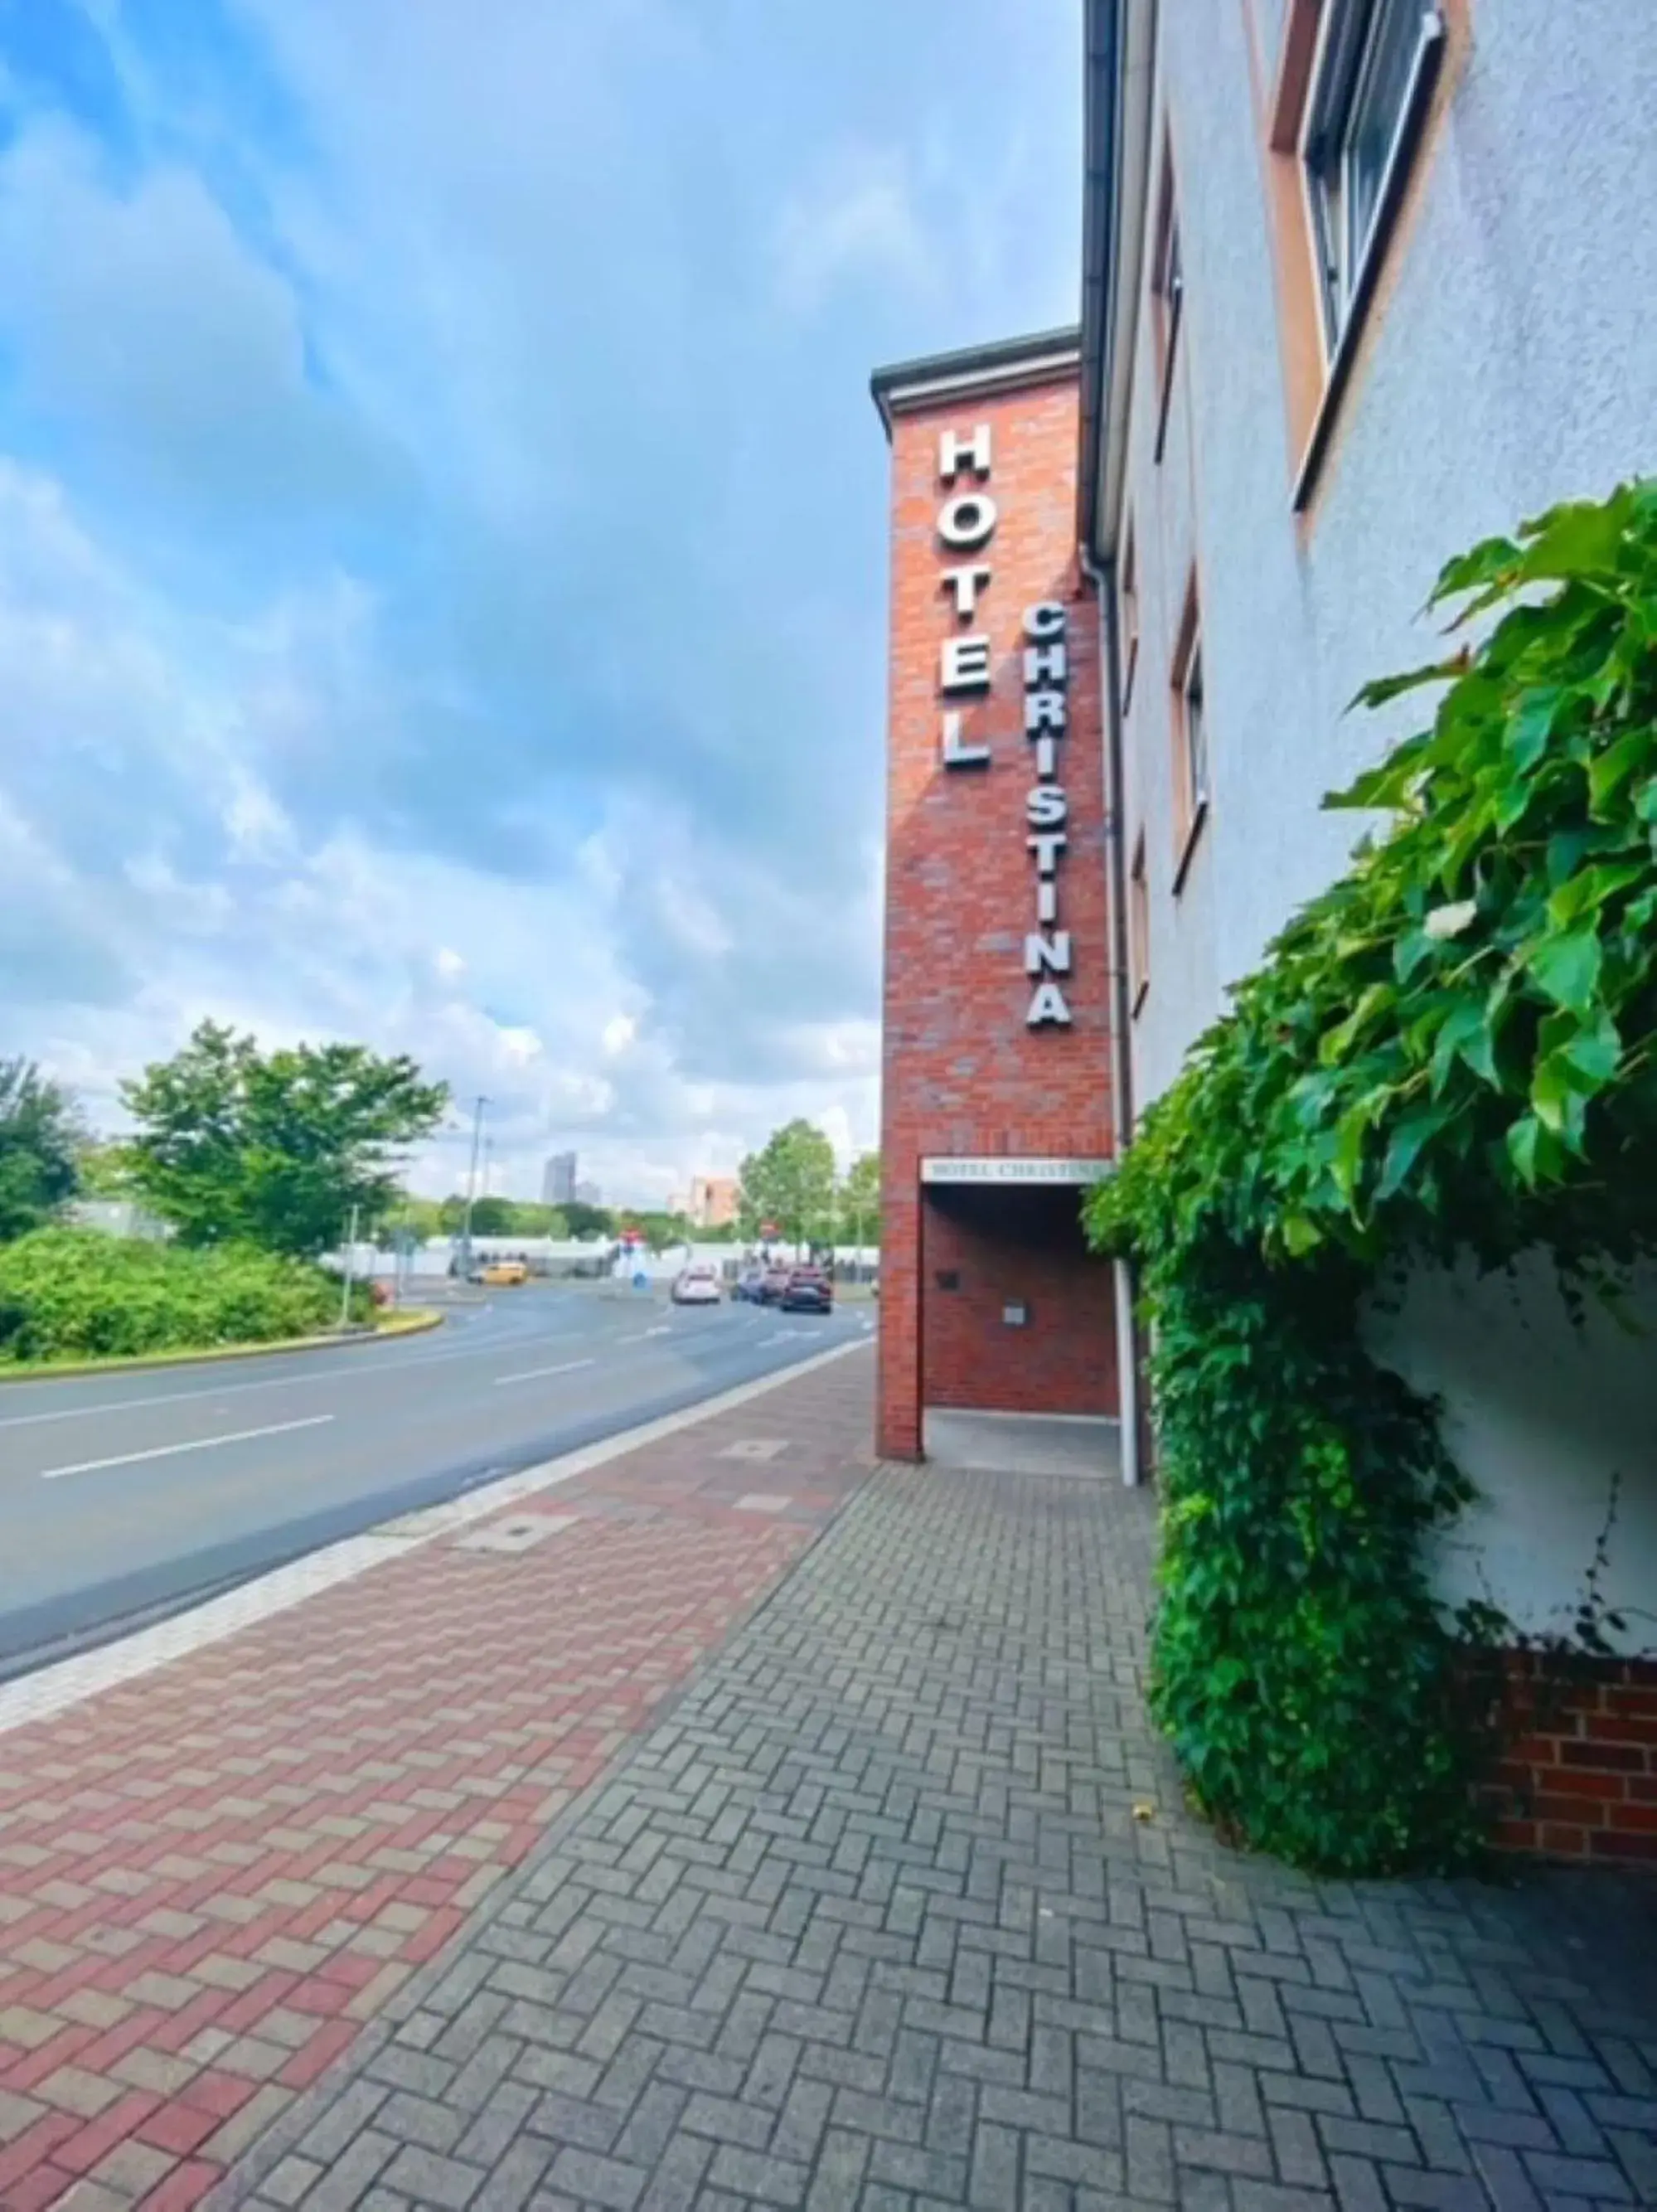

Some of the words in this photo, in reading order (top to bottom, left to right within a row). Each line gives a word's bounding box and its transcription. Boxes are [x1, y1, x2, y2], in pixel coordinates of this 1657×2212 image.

[938, 424, 995, 768] HOTEL
[1022, 601, 1072, 1028] CHRISTINA
[932, 1162, 991, 1177] HOTEL
